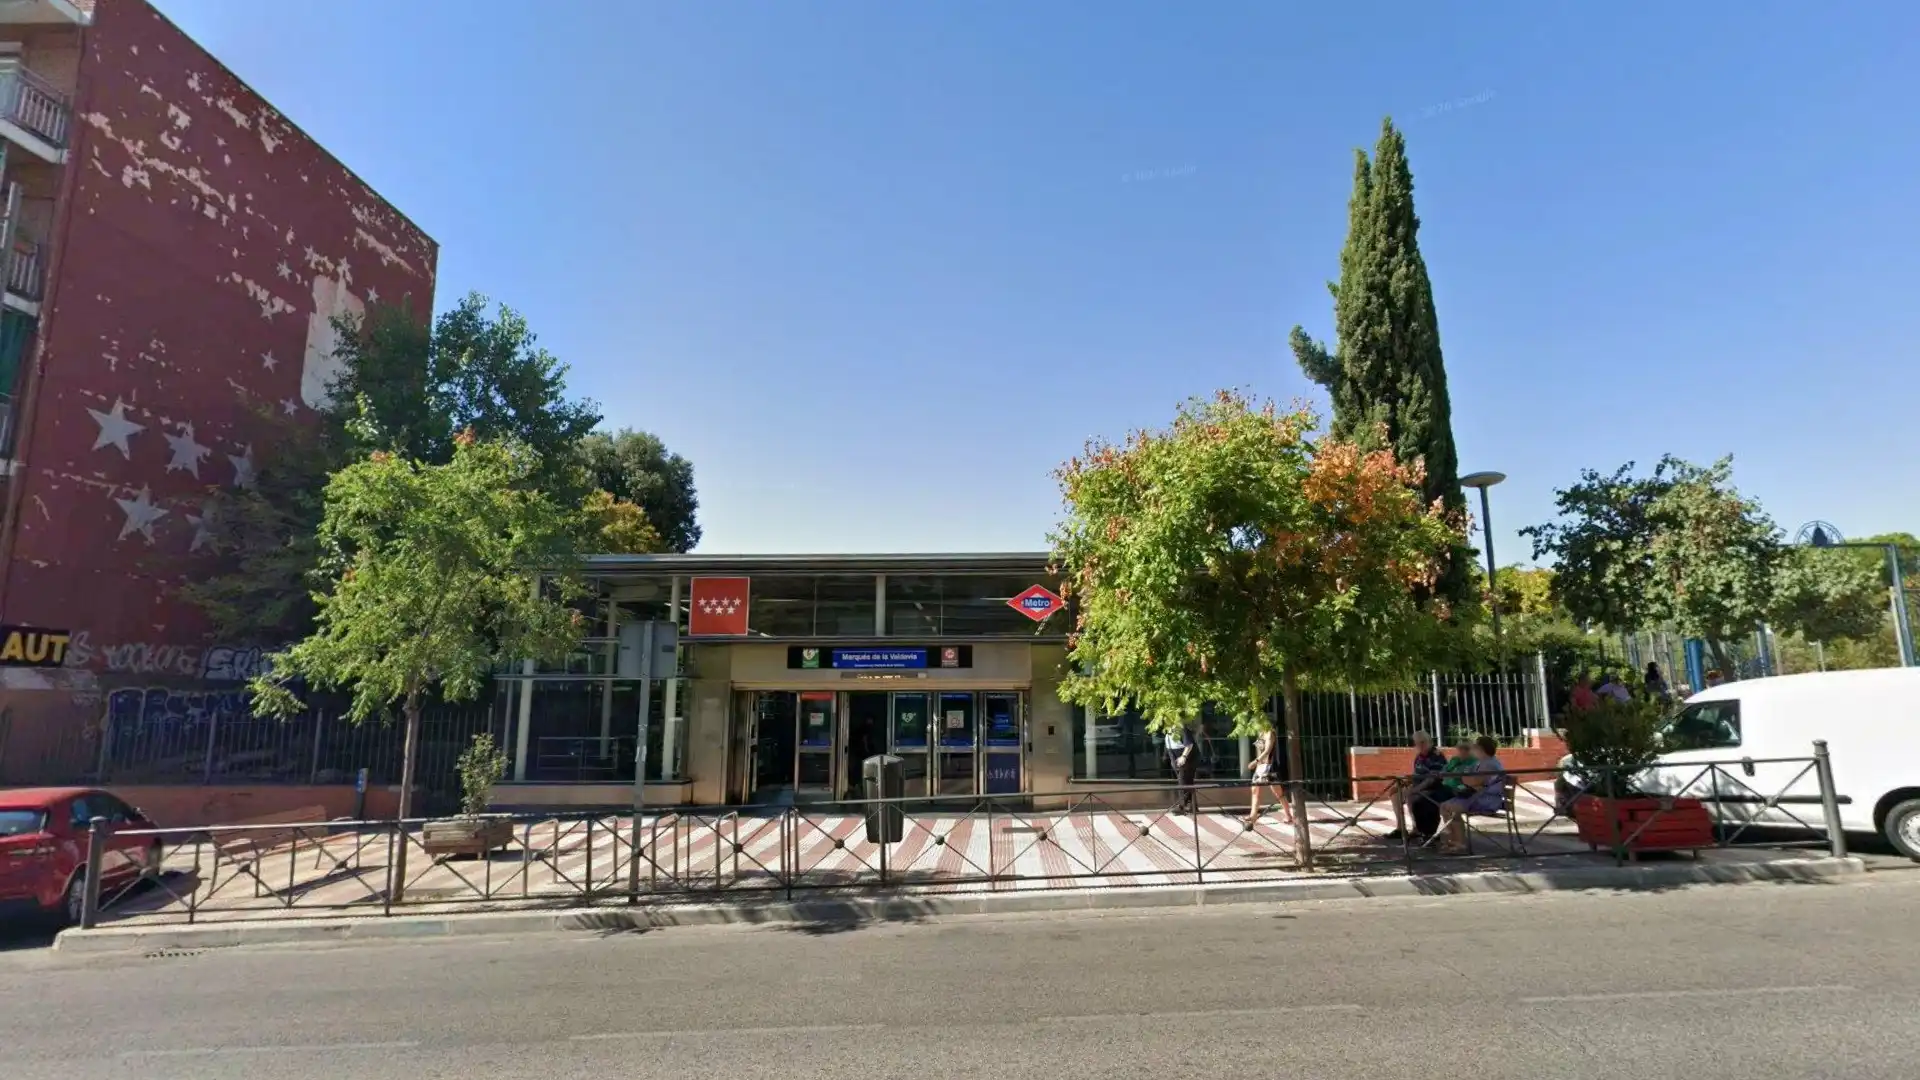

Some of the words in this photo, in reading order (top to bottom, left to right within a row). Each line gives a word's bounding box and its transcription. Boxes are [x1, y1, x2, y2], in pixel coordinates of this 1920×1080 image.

[1024, 598, 1050, 607] Metro
[1, 632, 69, 662] AUT
[842, 652, 871, 661] Marqués
